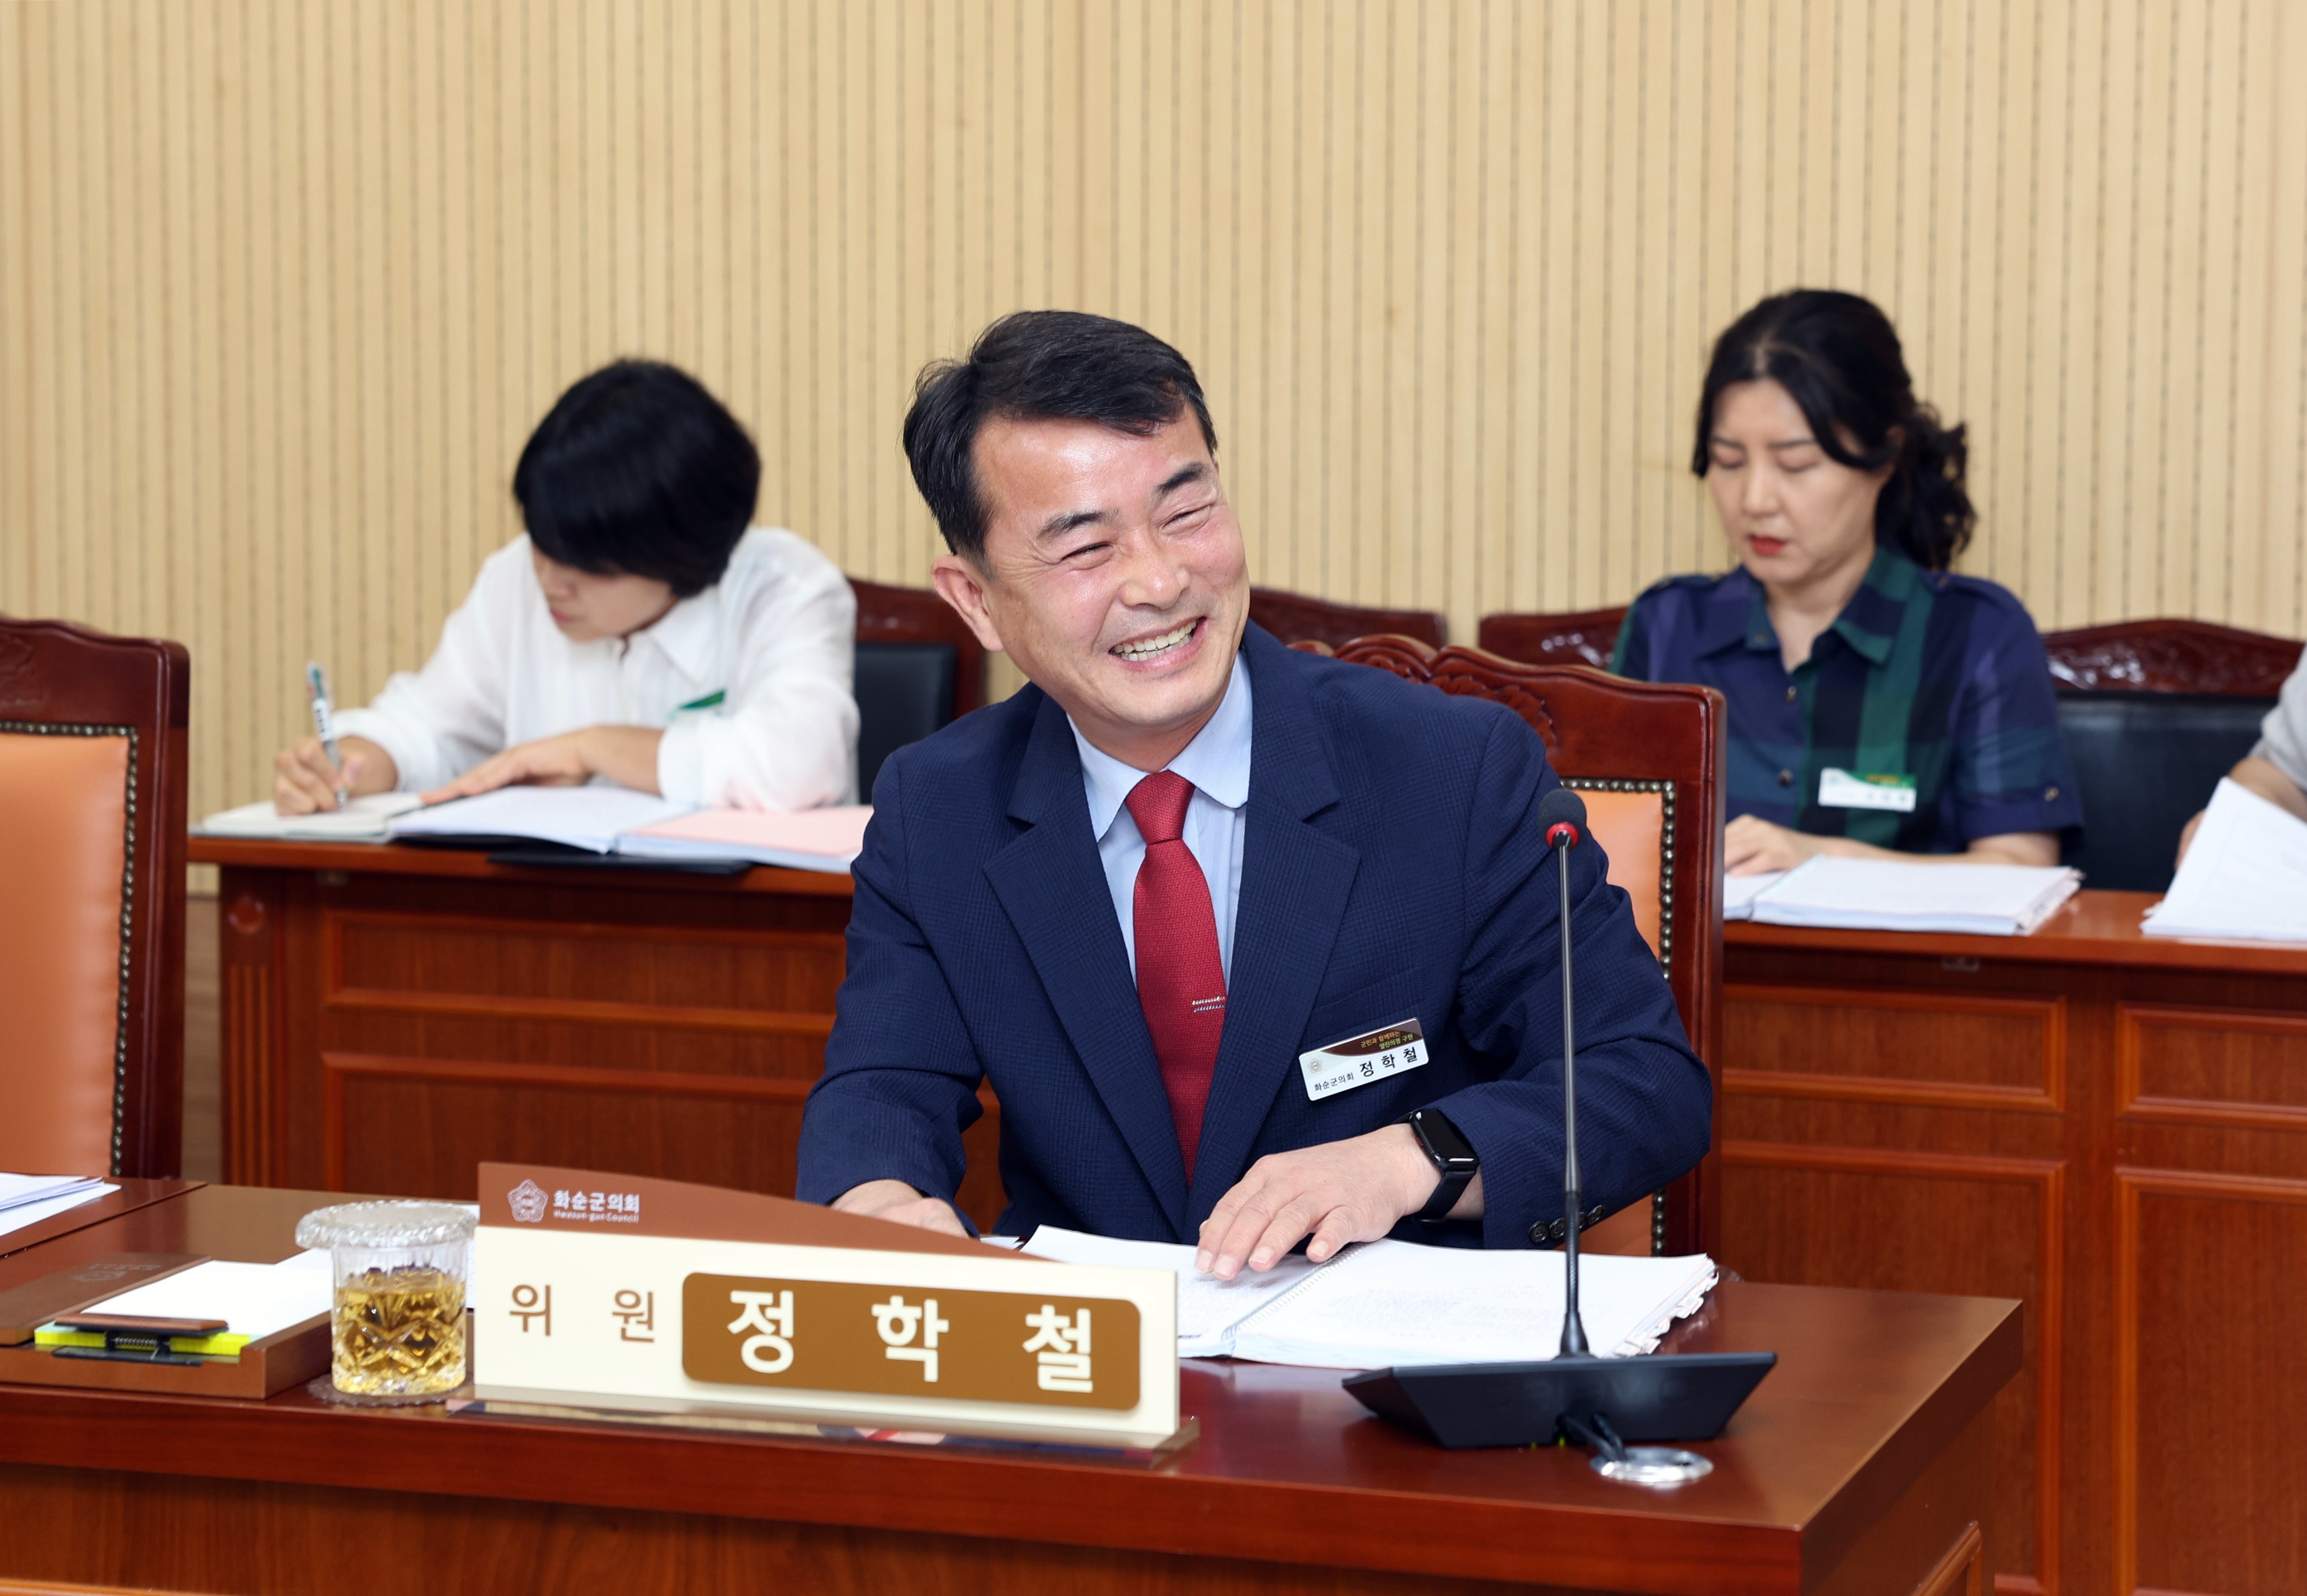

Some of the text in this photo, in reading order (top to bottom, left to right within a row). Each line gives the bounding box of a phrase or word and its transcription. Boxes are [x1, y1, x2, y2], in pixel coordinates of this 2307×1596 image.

[1361, 1031, 1400, 1048] 군민과 함께하는
[1379, 1034, 1413, 1050] 열린의정 구현
[1314, 1072, 1354, 1091] 화순군의회
[553, 1190, 640, 1213] 화순군의회
[606, 1212, 640, 1223] Council
